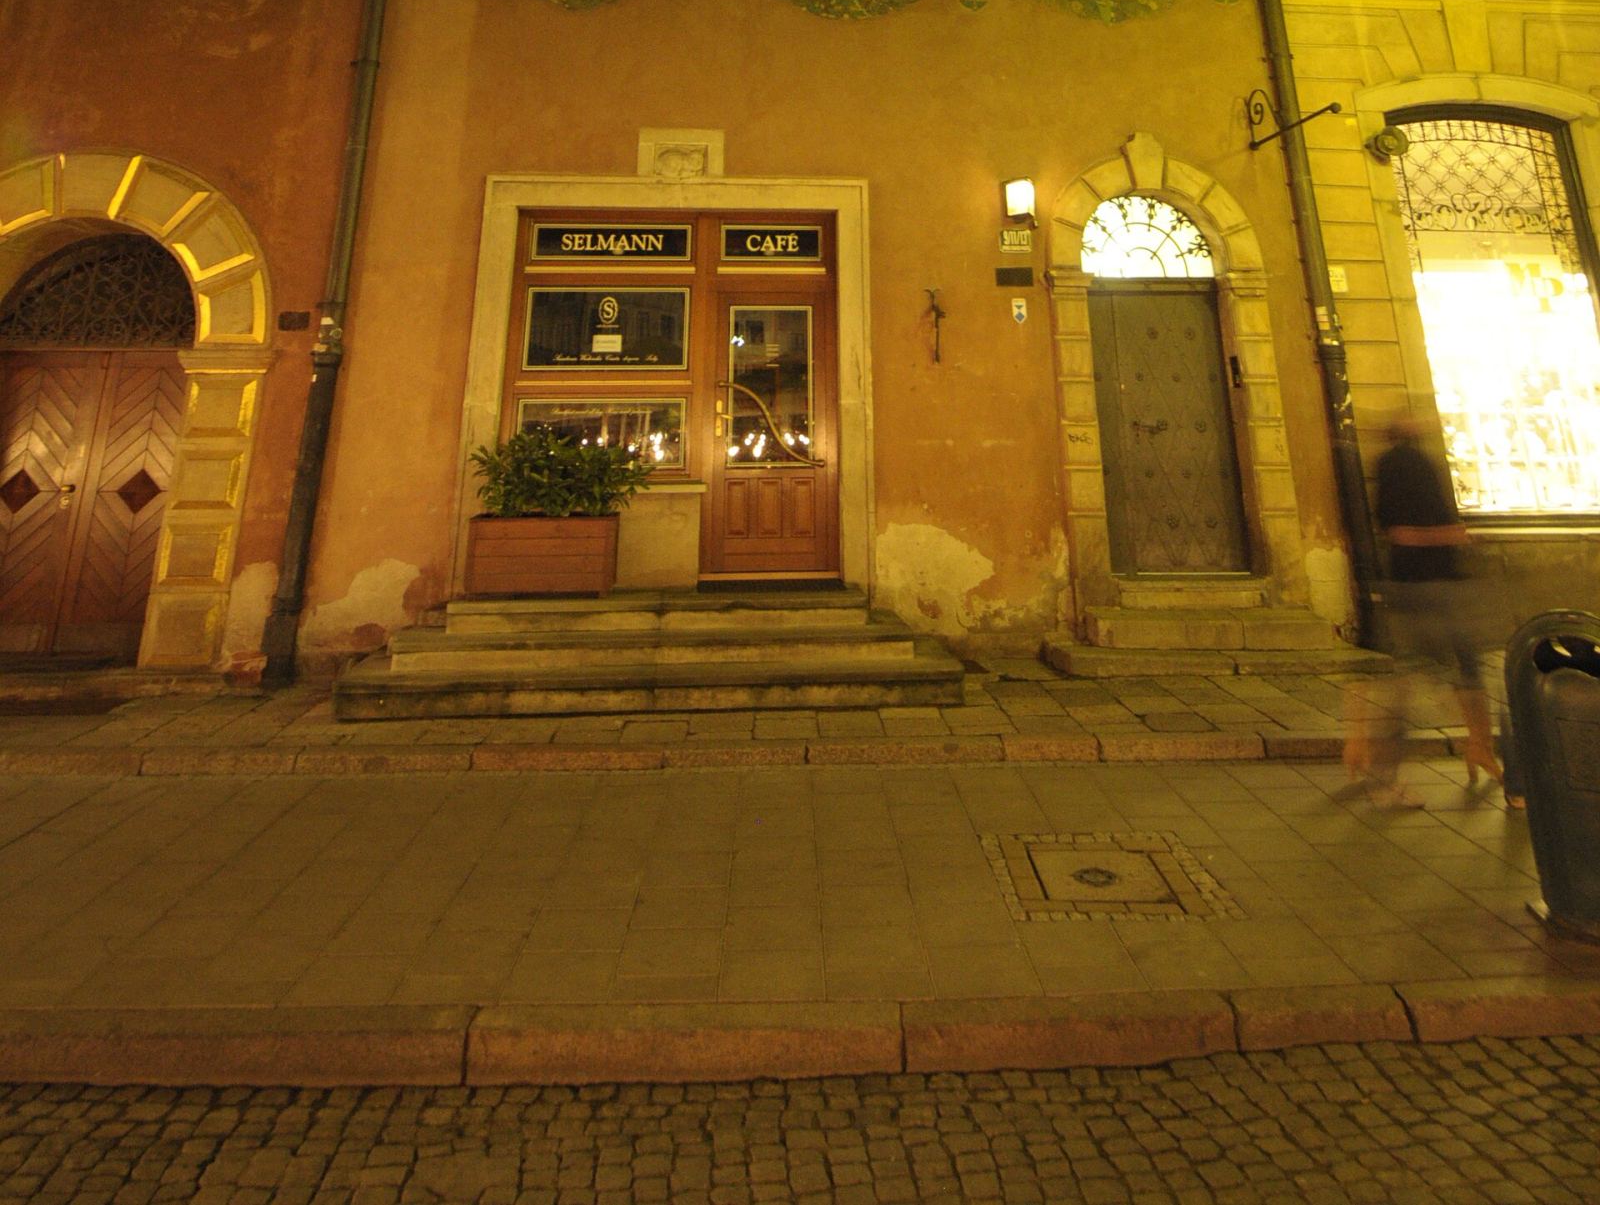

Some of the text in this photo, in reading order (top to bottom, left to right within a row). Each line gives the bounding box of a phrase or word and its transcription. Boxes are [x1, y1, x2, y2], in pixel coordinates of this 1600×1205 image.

[561, 233, 800, 252] SELMANN CAFÉ
[603, 302, 614, 319] S
